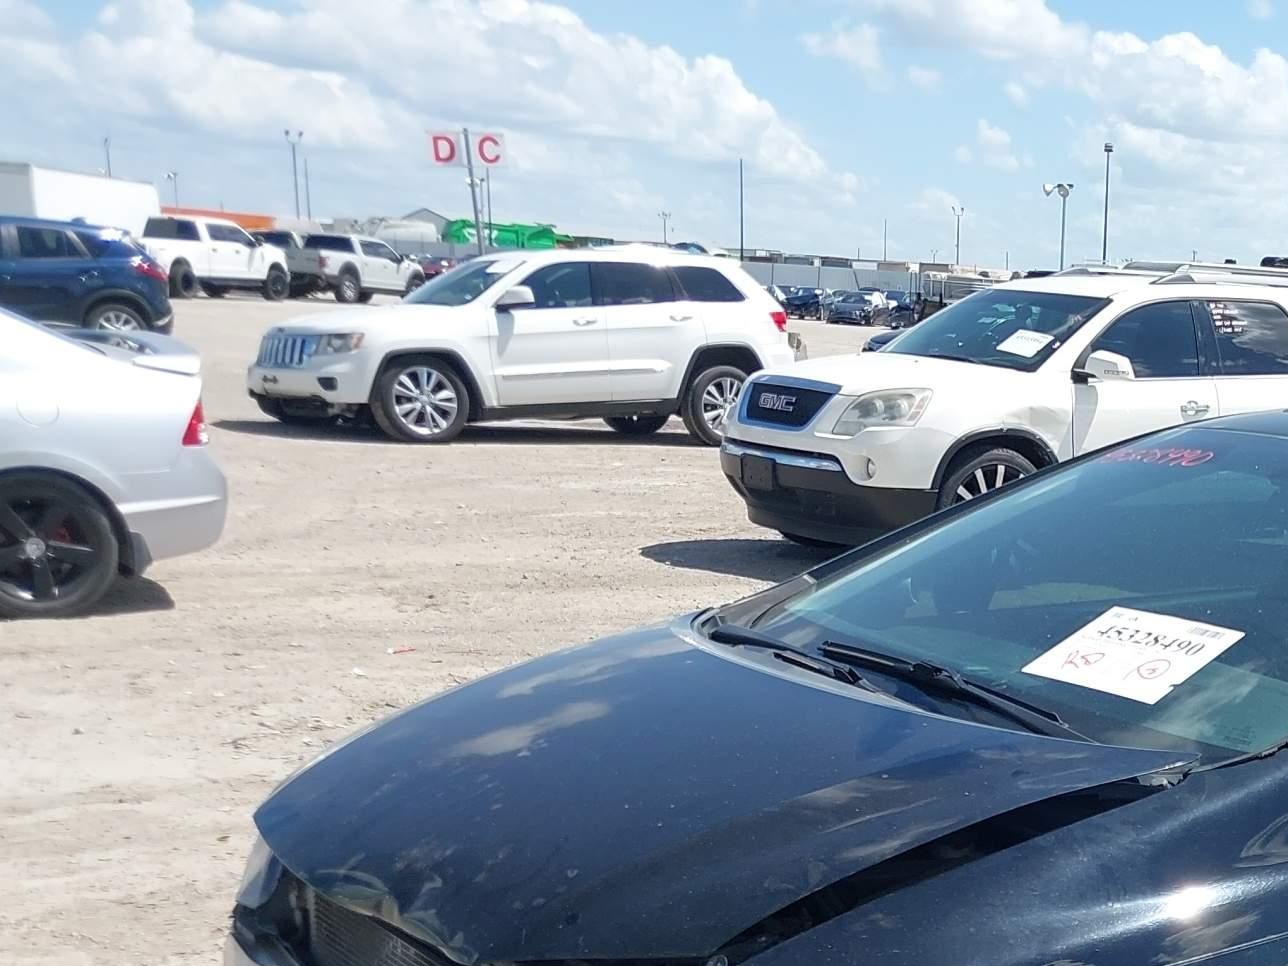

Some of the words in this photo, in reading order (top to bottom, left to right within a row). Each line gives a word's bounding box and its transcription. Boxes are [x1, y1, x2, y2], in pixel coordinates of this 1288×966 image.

[432, 136, 455, 162] D
[478, 136, 500, 163] C
[759, 392, 796, 412] GMC
[1097, 625, 1206, 656] 45328490
